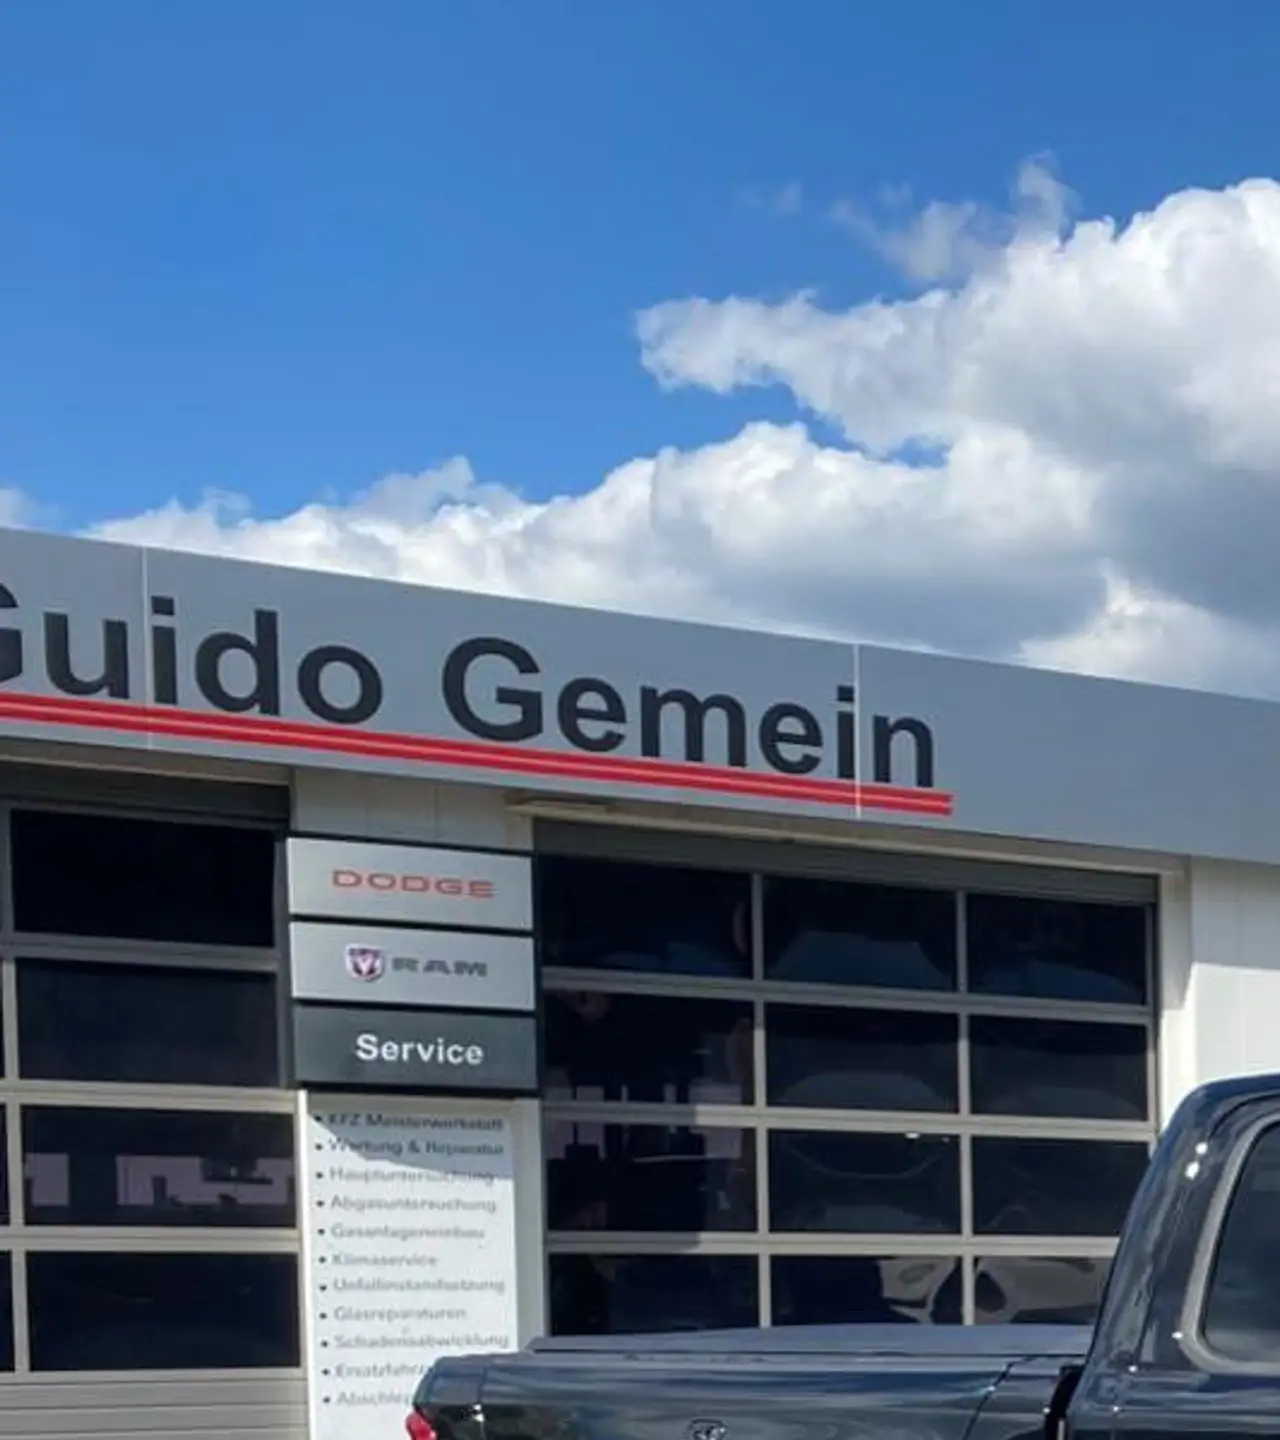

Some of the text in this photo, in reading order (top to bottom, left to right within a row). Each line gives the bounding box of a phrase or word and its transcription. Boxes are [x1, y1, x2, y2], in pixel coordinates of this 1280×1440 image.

[0, 583, 935, 790] uido Gemein
[332, 870, 495, 899] DODGE
[392, 956, 487, 978] RAM
[355, 1033, 484, 1065] Service
[407, 1140, 421, 1154] &
